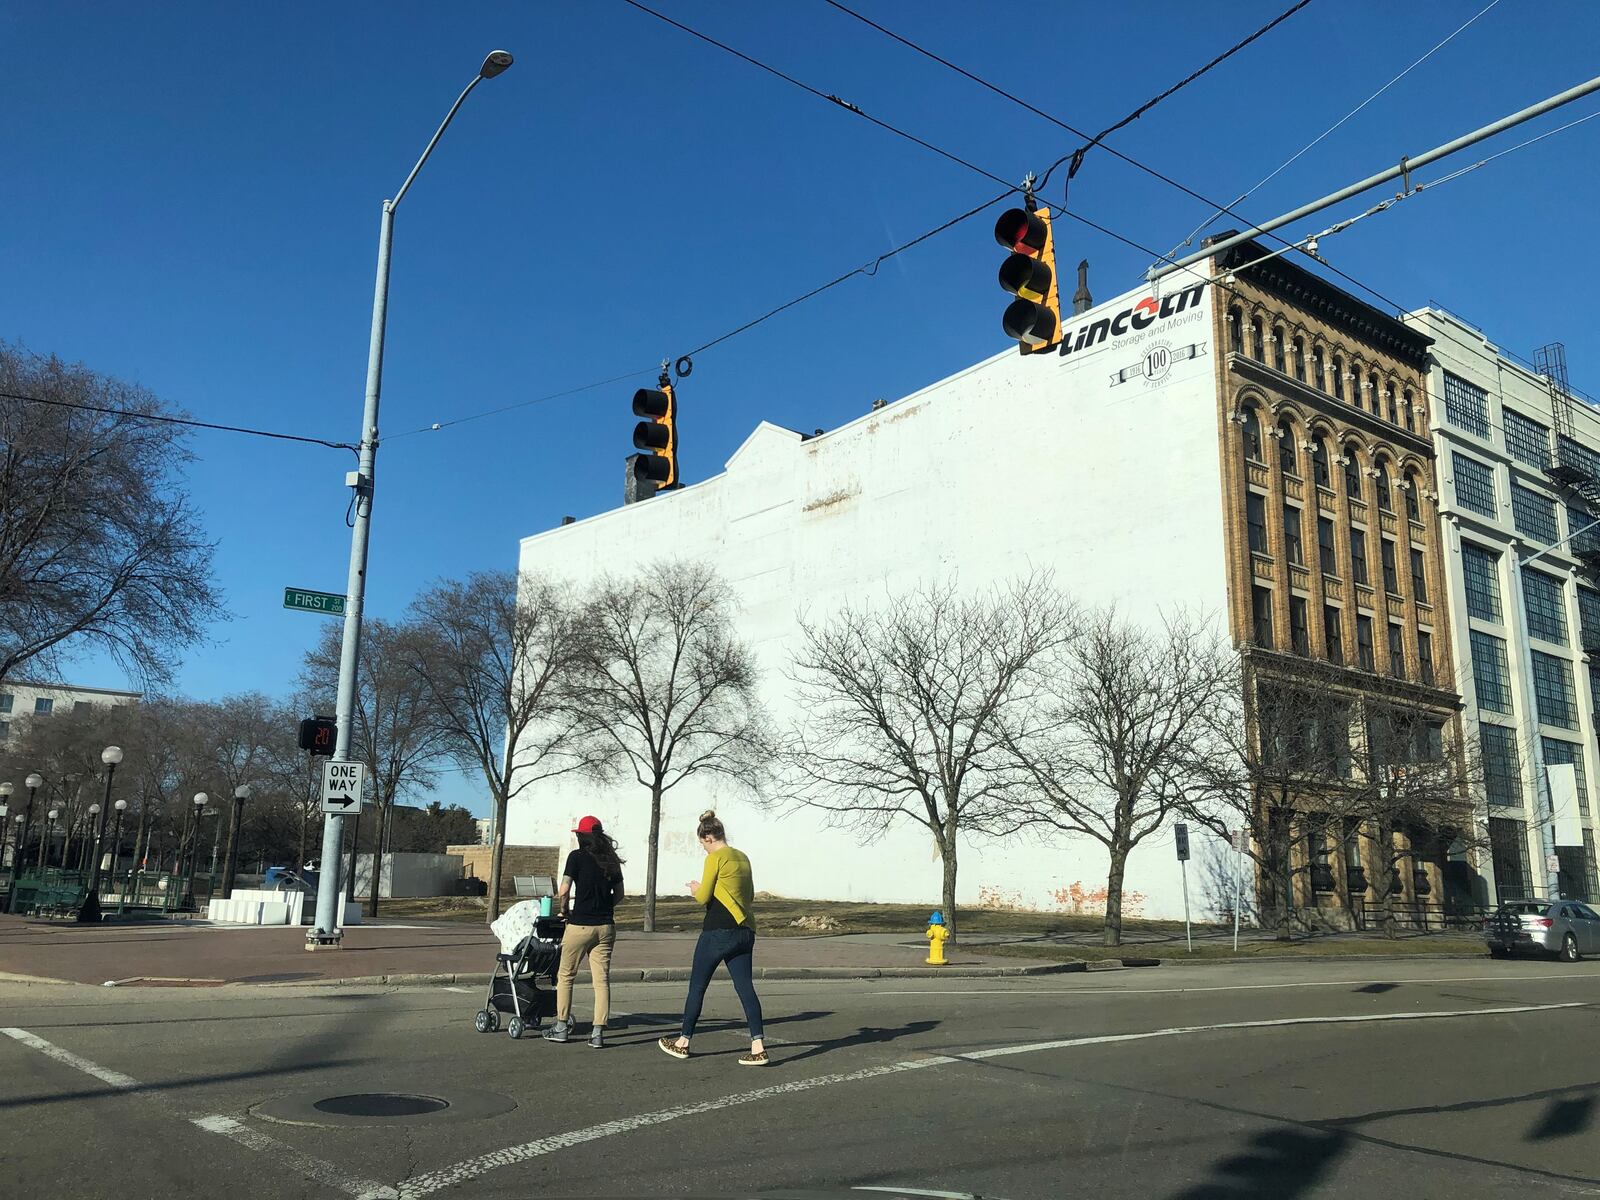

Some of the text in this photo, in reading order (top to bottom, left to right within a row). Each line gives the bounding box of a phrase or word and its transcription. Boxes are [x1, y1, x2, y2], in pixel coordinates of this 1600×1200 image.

[1111, 311, 1204, 351] Storage and Moving
[1147, 348, 1167, 377] 100
[1172, 351, 1186, 361] 2016
[295, 594, 328, 608] FIRST
[315, 727, 330, 745] 20
[331, 766, 357, 777] ONE
[329, 780, 357, 791] WAY
